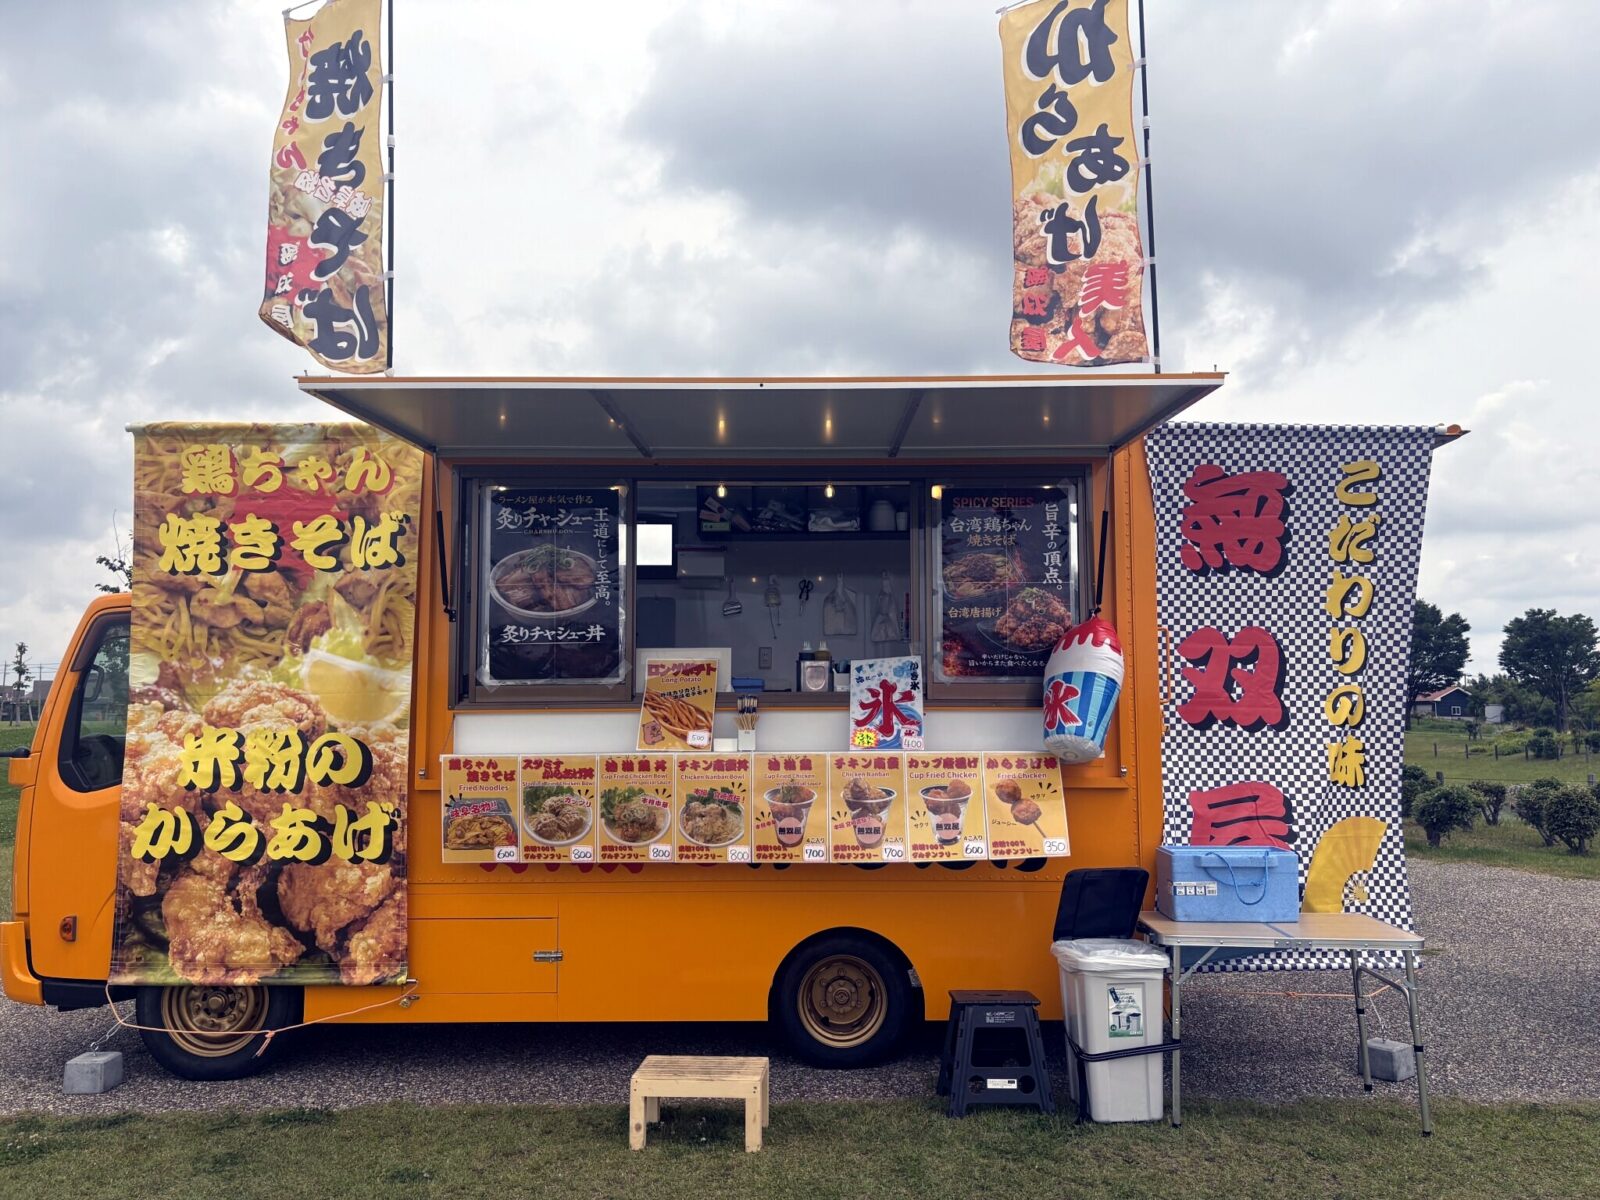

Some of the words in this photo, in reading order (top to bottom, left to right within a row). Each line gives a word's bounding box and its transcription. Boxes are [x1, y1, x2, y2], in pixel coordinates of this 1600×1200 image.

[180, 442, 396, 496] 鶏ちゃん
[498, 494, 594, 505] ラーメン屋が本気で作る
[953, 497, 988, 508] SPICY
[991, 497, 1034, 508] SERIES
[495, 507, 594, 530] 炙りチャーシュー
[950, 517, 1032, 533] 台湾鶏ちゃん
[158, 509, 409, 576] 焼きそば
[966, 534, 1018, 547] 焼きそば
[1042, 503, 1063, 591] 旨辛の頂点。
[593, 507, 611, 606] 王道にして至高。
[949, 606, 1002, 619] 台湾唐揚げ
[1323, 458, 1382, 789] こだわりの味
[500, 624, 606, 643] 炙りチャシュー丼
[647, 663, 717, 676] ロングポテト
[909, 661, 920, 691] かき氷
[852, 679, 921, 738] 氷
[691, 734, 705, 742] 500
[904, 739, 922, 748] 400
[175, 724, 374, 795] 米粉の
[522, 758, 564, 770] スタミナ
[466, 770, 517, 783] 焼きそば
[909, 772, 924, 780] Cup
[131, 800, 403, 867] からあげ
[965, 844, 984, 855] 600
[992, 848, 1041, 857] グルテンフリー
[1044, 841, 1066, 852] 350
[496, 850, 515, 859] 600
[572, 850, 592, 859] 800
[651, 848, 671, 858] 800
[730, 850, 749, 861] 800
[805, 848, 825, 859] 700
[884, 848, 904, 859] 700
[911, 851, 959, 859] グルテンフリー
